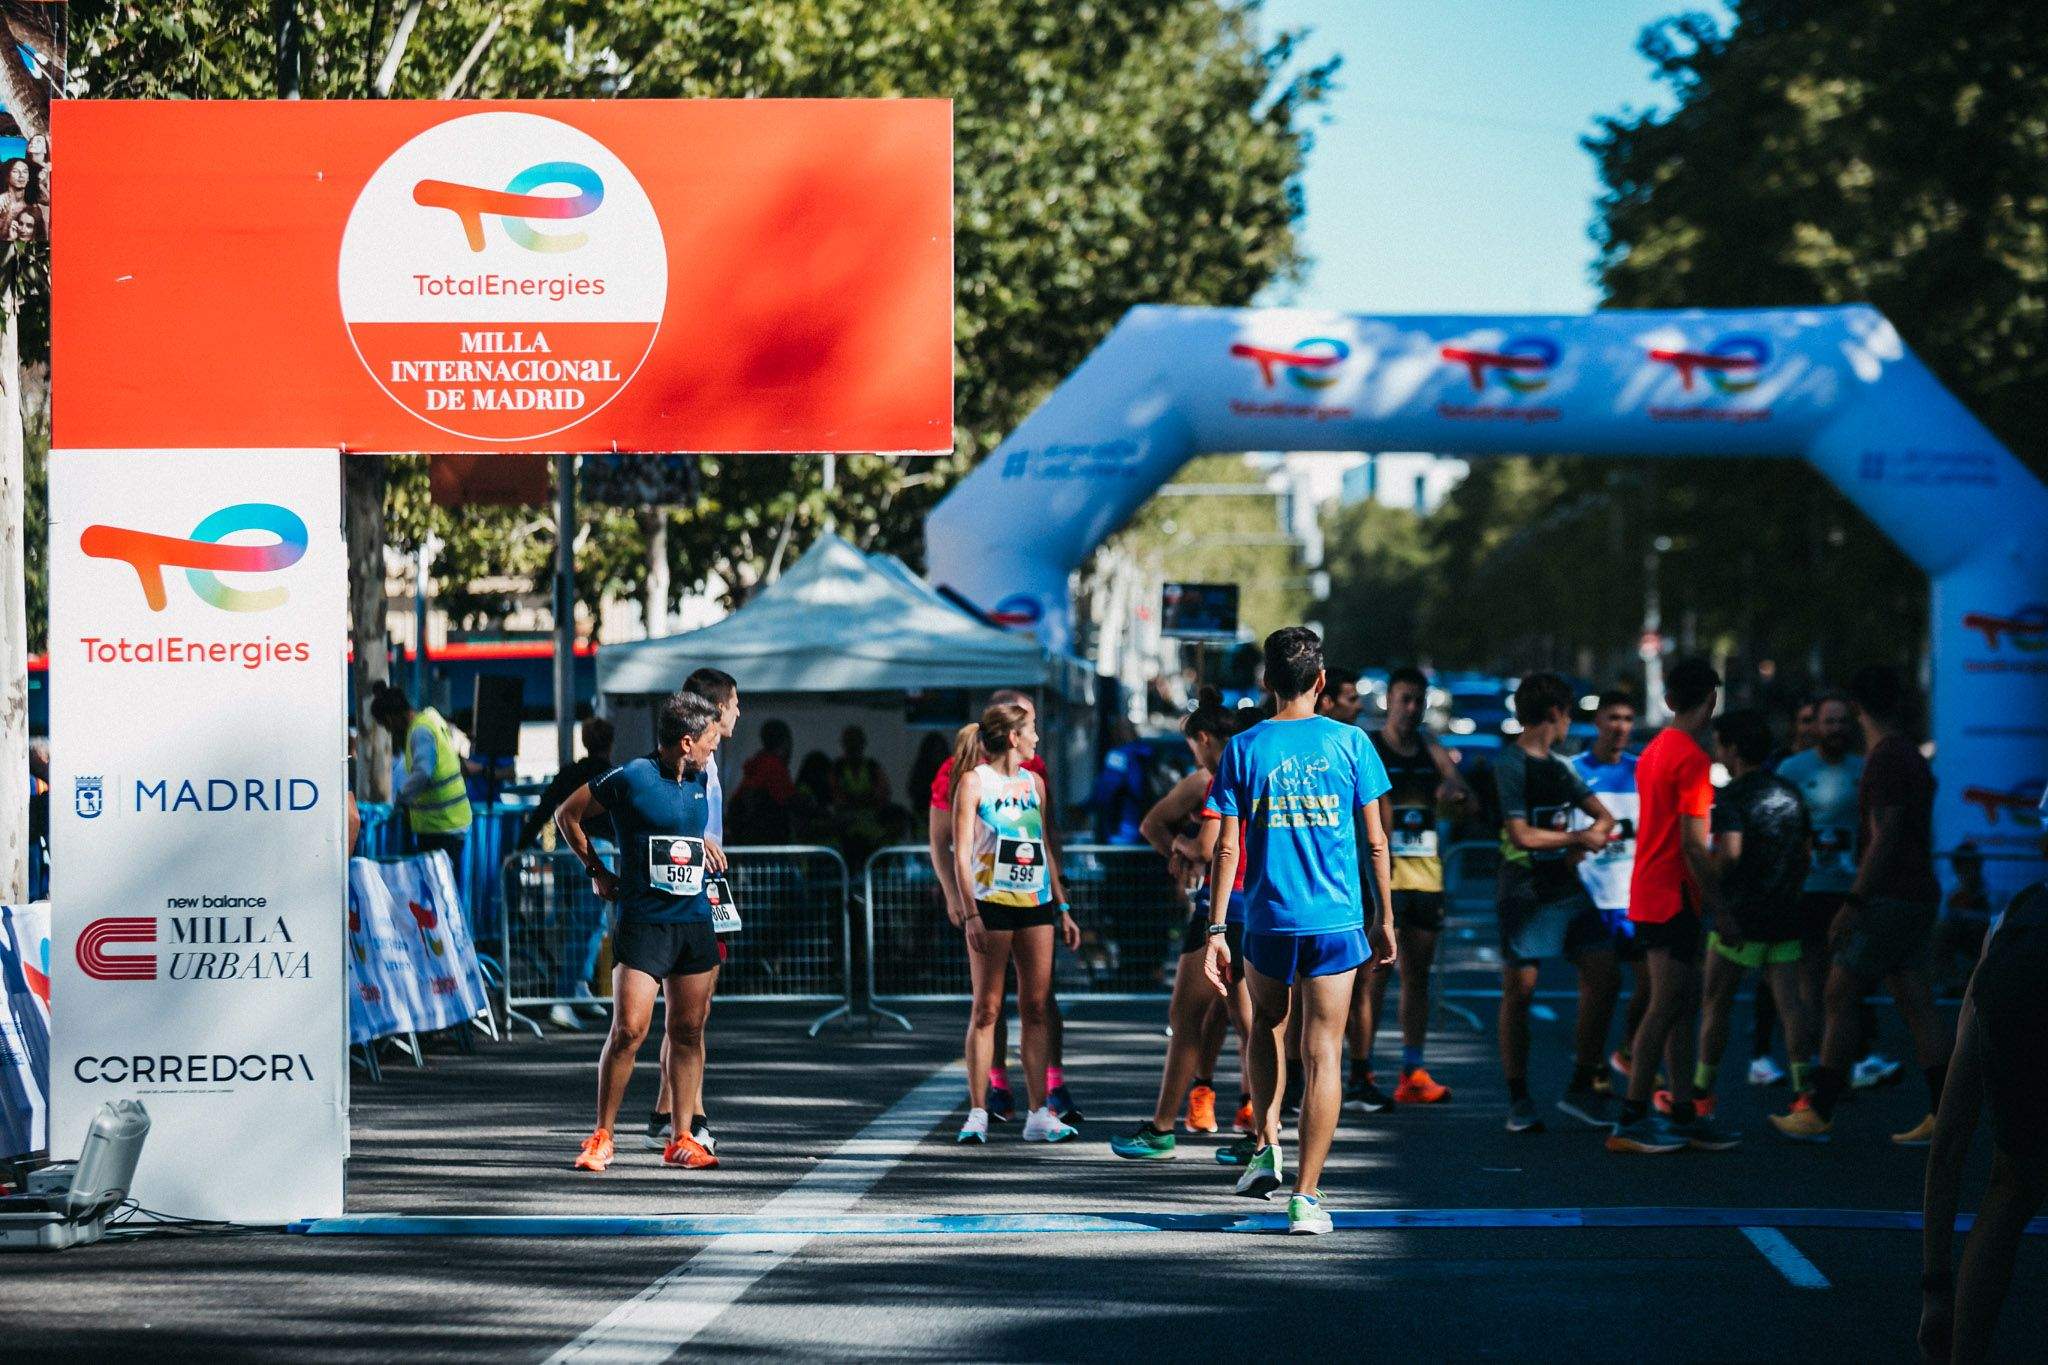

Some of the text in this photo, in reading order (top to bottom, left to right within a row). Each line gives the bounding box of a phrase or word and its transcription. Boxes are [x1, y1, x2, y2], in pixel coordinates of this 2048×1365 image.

[413, 274, 605, 300] TotalEnergies
[460, 331, 552, 353] MILLA
[425, 389, 586, 411] DE MADRID
[80, 636, 310, 669] TotalEnergies
[136, 779, 319, 812] MADRID
[667, 866, 693, 883] 592
[167, 895, 267, 909] new balance
[169, 916, 293, 944] MILLA
[169, 952, 313, 980] URBANA
